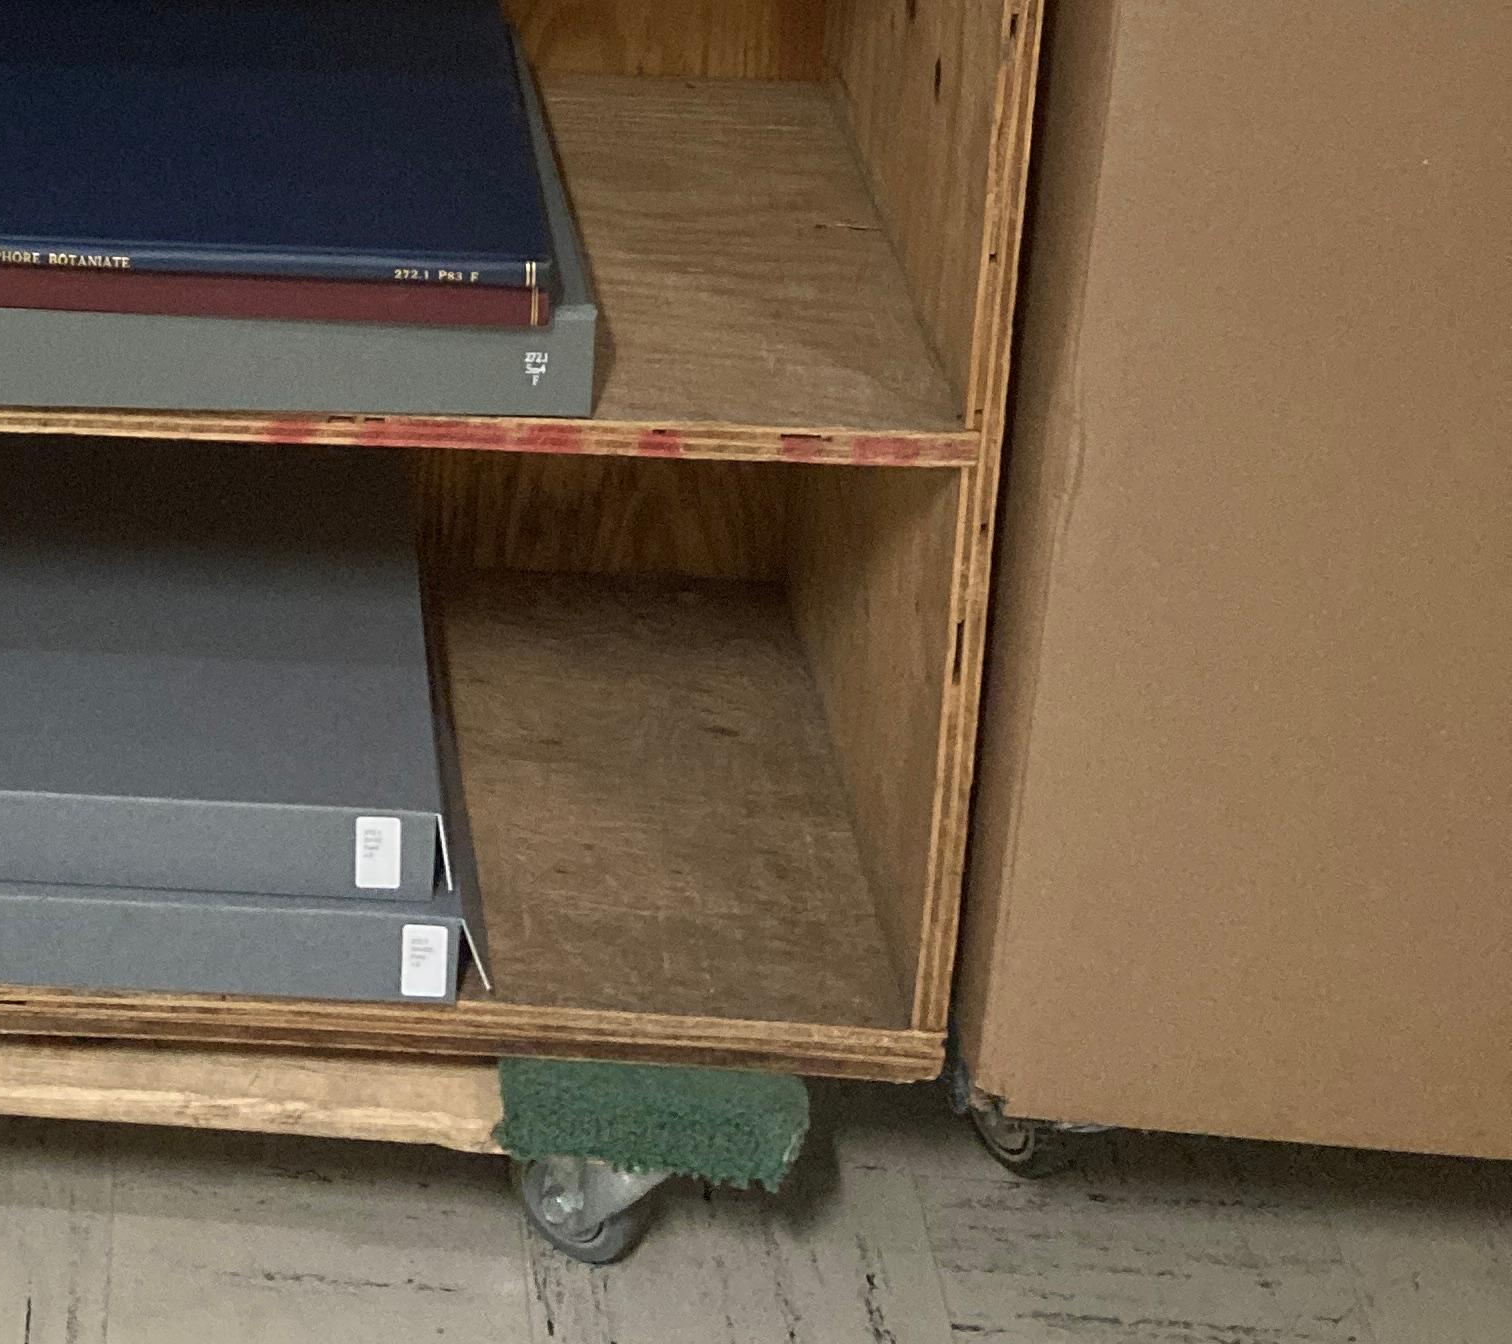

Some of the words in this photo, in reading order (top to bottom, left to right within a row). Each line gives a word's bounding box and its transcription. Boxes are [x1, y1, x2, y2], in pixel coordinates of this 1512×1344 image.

[49, 254, 131, 268] BOTANIATE
[394, 269, 429, 280] 272.1
[470, 271, 479, 282] F
